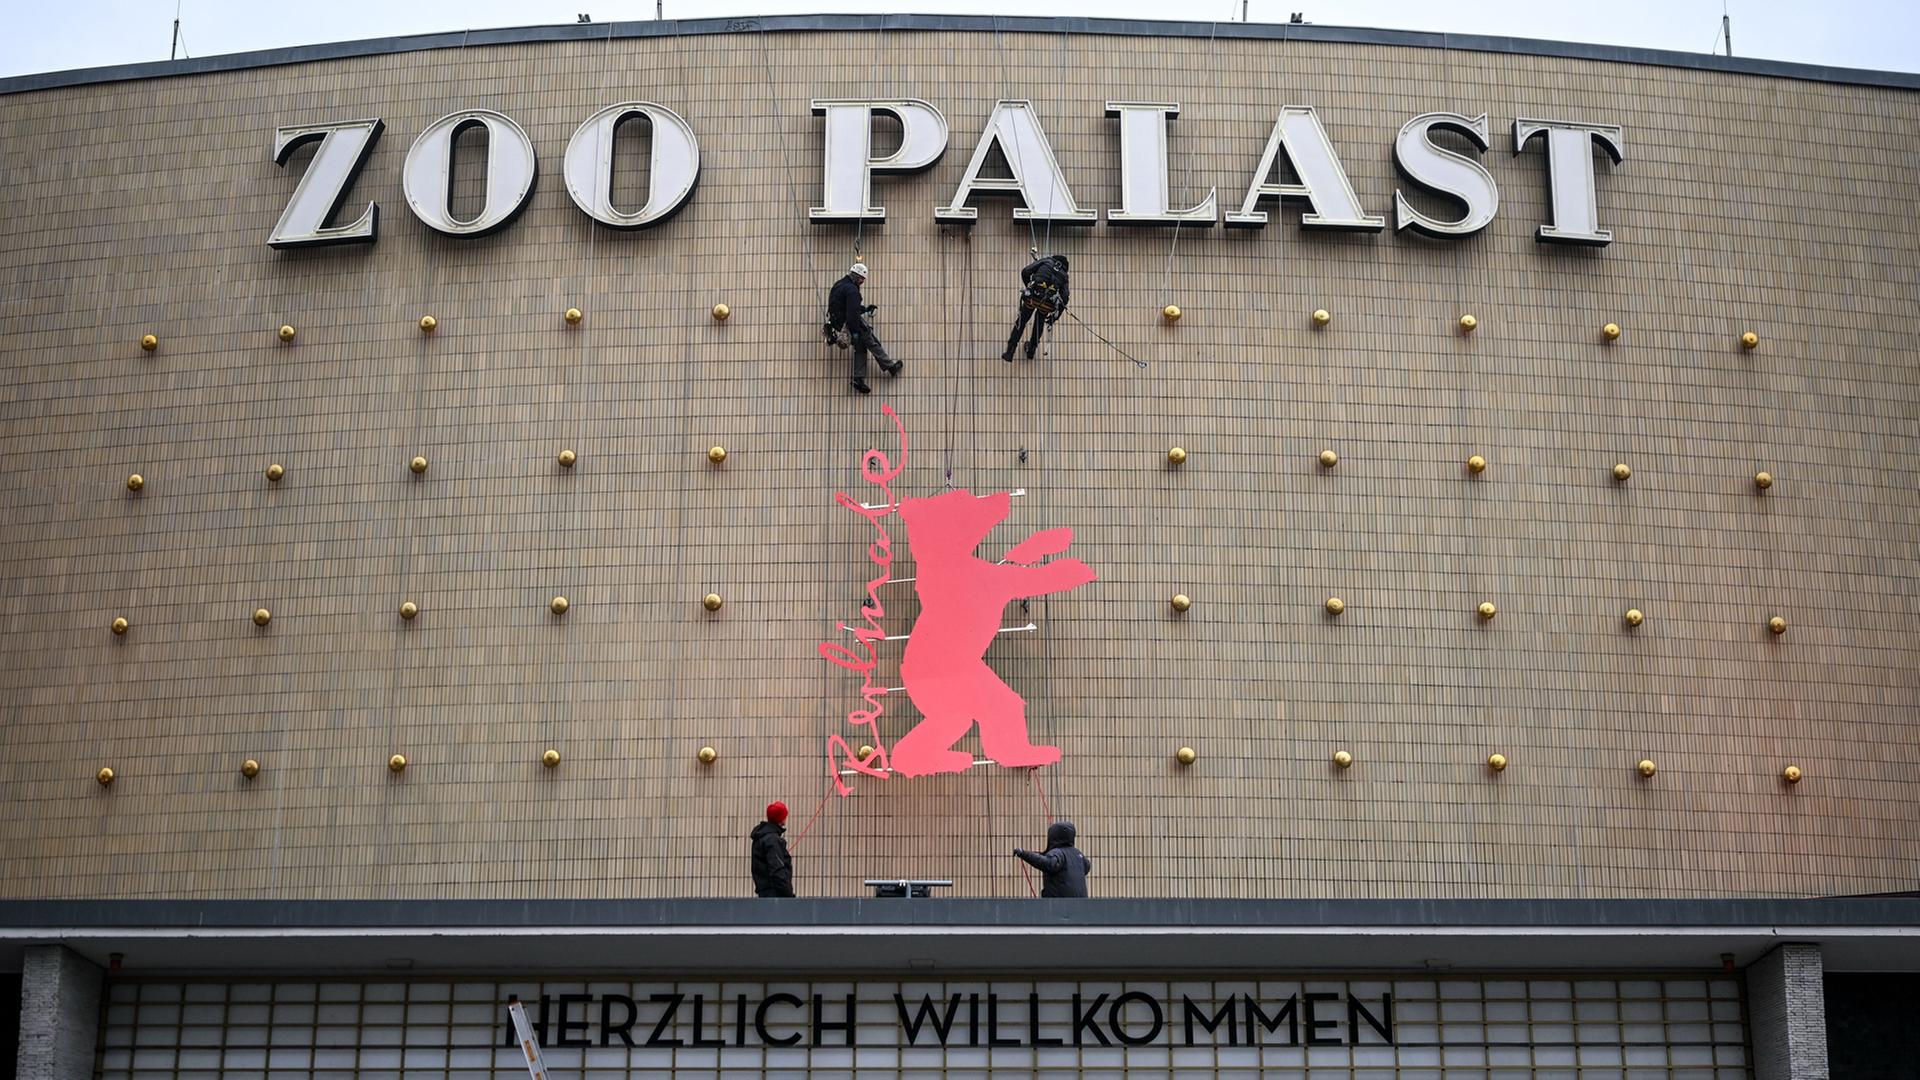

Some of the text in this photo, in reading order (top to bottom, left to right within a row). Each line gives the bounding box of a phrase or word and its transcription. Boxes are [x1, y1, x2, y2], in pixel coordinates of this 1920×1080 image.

[268, 98, 1624, 248] ZOO PALAST
[819, 402, 907, 797] Berlinale
[505, 991, 1394, 1048] HERZLICH WILLKOMMEN
